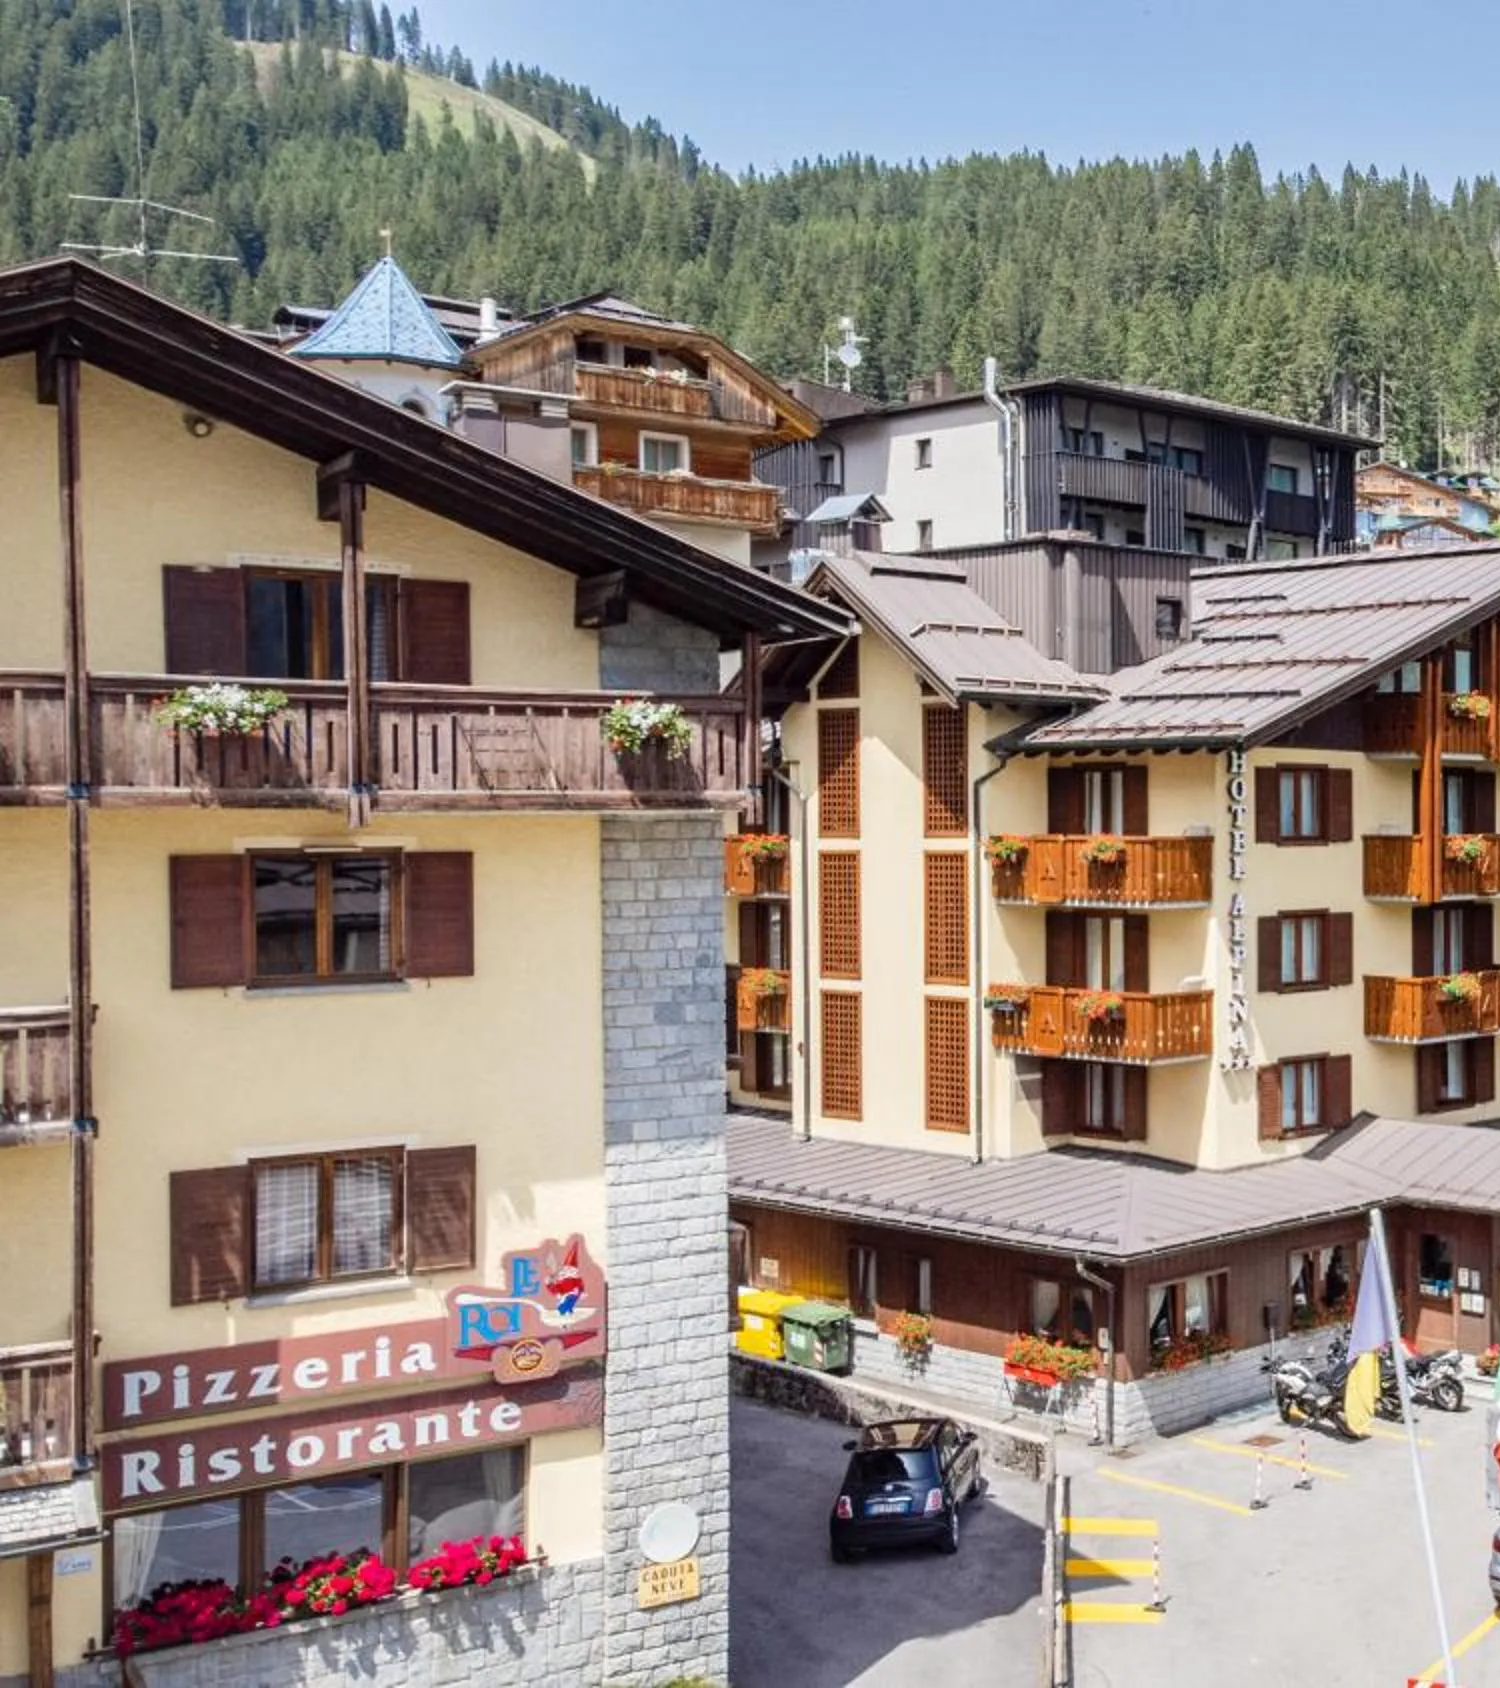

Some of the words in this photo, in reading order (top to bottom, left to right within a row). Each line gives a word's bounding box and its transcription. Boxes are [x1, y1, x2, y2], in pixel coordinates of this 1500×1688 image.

[1229, 750, 1247, 880] HOTEL
[121, 1335, 437, 1418] Pizzeria
[121, 1399, 524, 1498] Ristorante
[651, 1579, 685, 1595] NEVE
